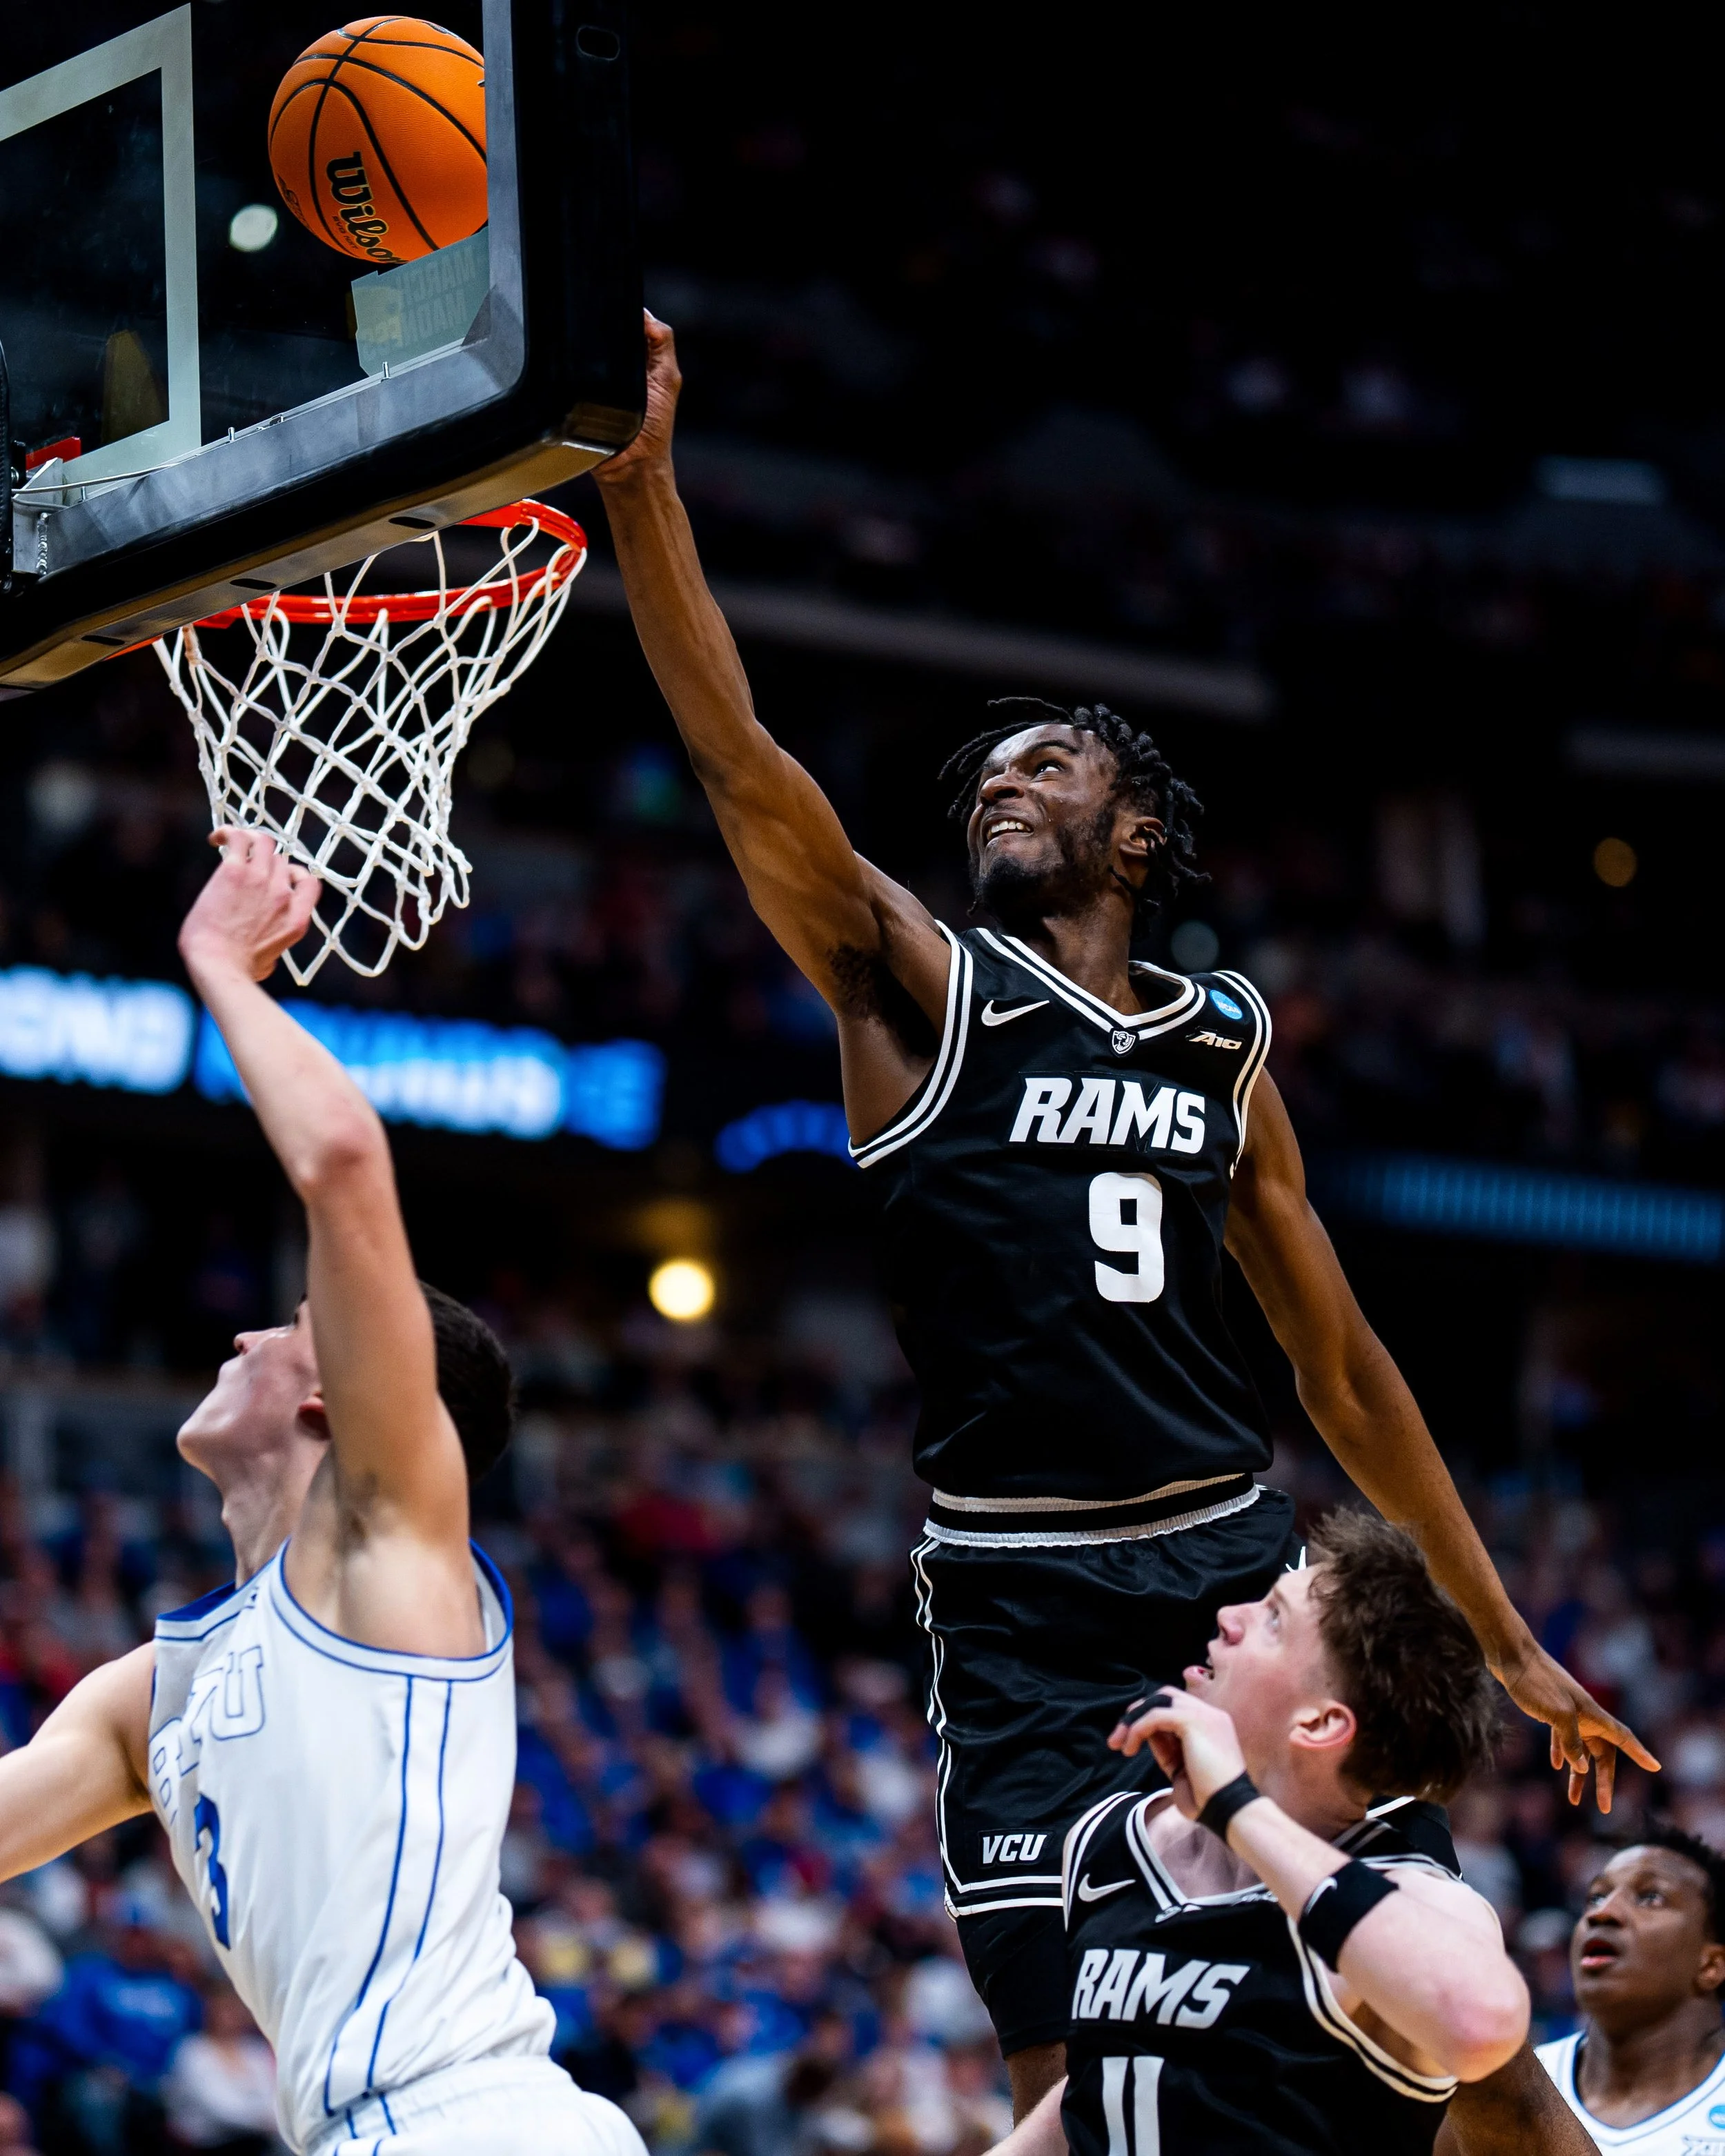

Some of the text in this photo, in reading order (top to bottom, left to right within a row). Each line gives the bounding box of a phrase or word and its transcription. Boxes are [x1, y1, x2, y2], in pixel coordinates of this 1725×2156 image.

[1009, 1077, 1205, 1154] RAMS
[1089, 1172, 1164, 1303] 9
[983, 1834, 1047, 1863] VCU
[1071, 1948, 1250, 2029] RAMS
